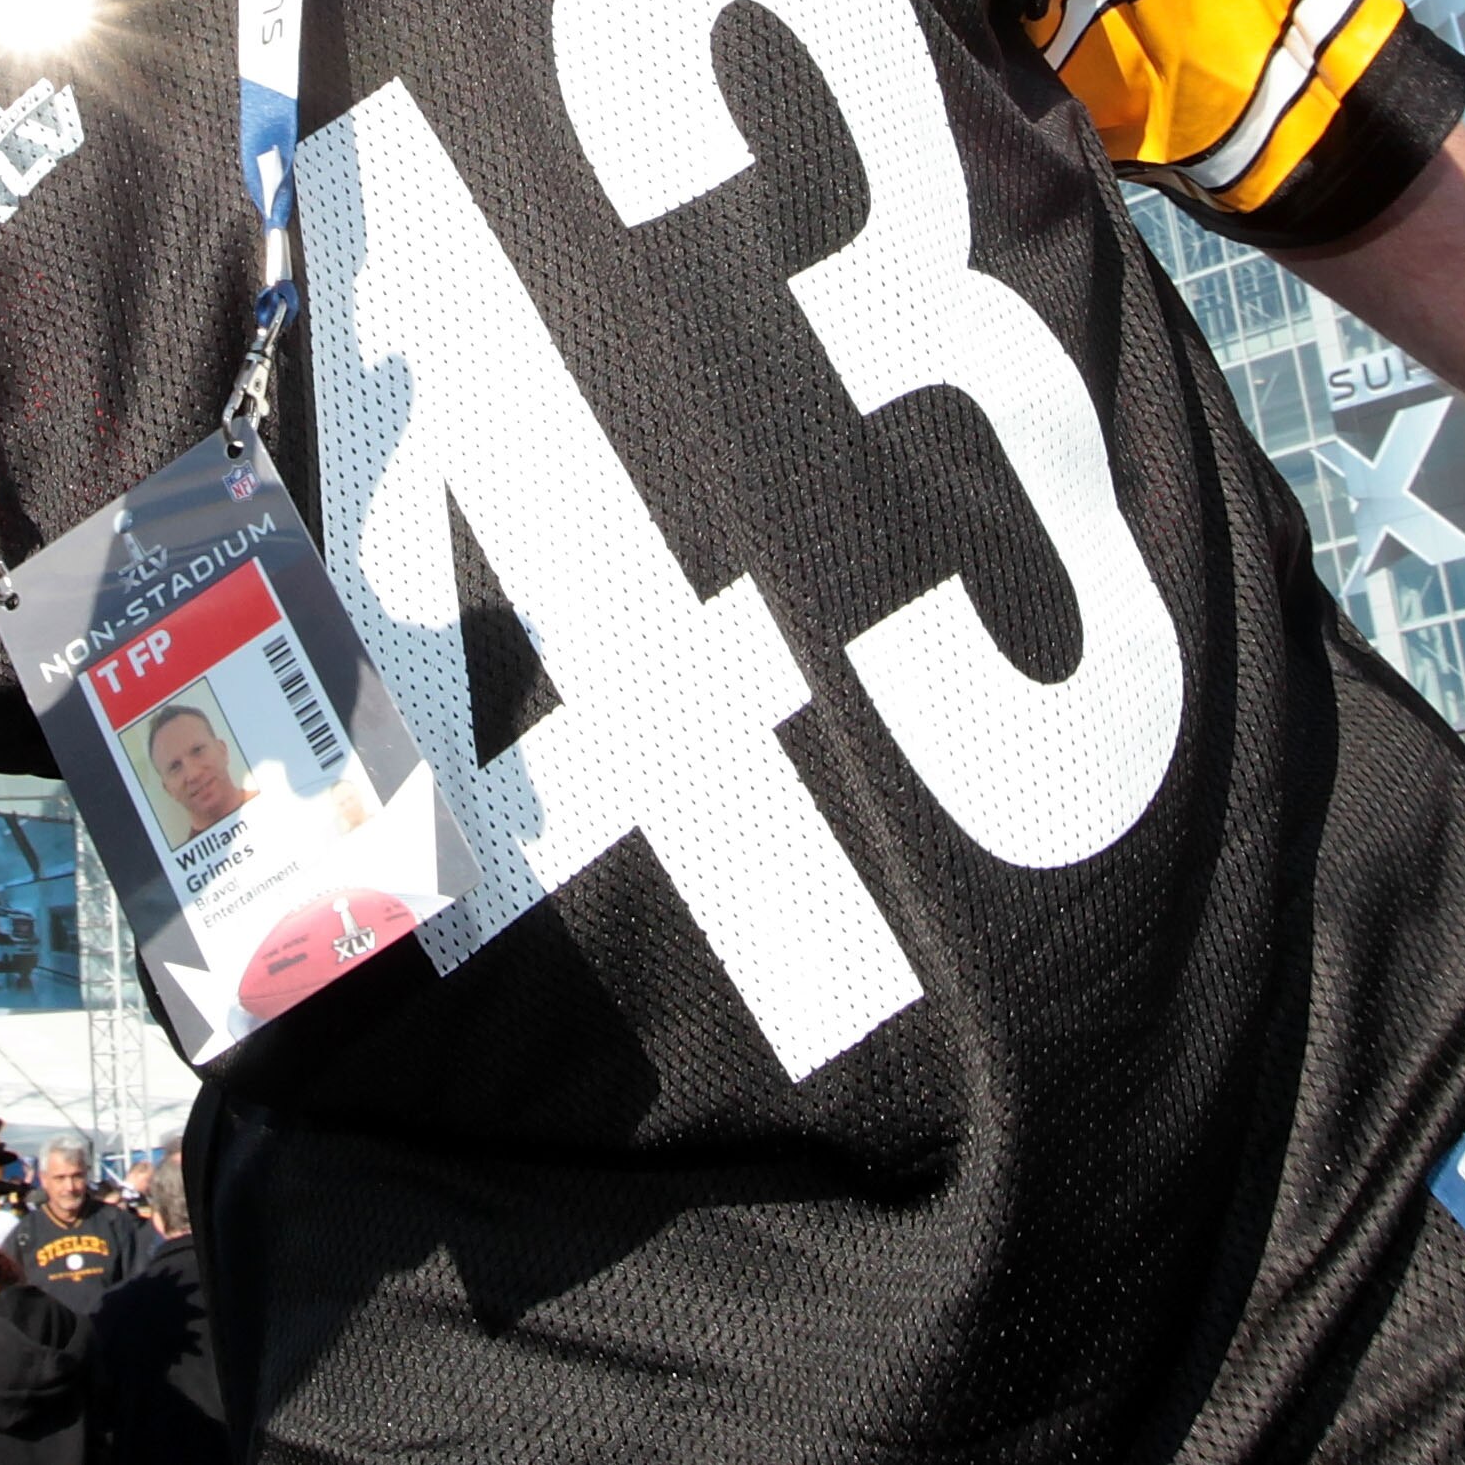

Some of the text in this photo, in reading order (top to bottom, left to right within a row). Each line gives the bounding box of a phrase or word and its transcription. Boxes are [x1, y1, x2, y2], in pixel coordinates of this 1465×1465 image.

[229, 475, 258, 502] NFL
[39, 512, 277, 684] NON-STADIUM
[175, 819, 249, 873] William
[185, 844, 255, 894] Grimes
[202, 861, 302, 929] Entertainment
[333, 930, 376, 962] XLV
